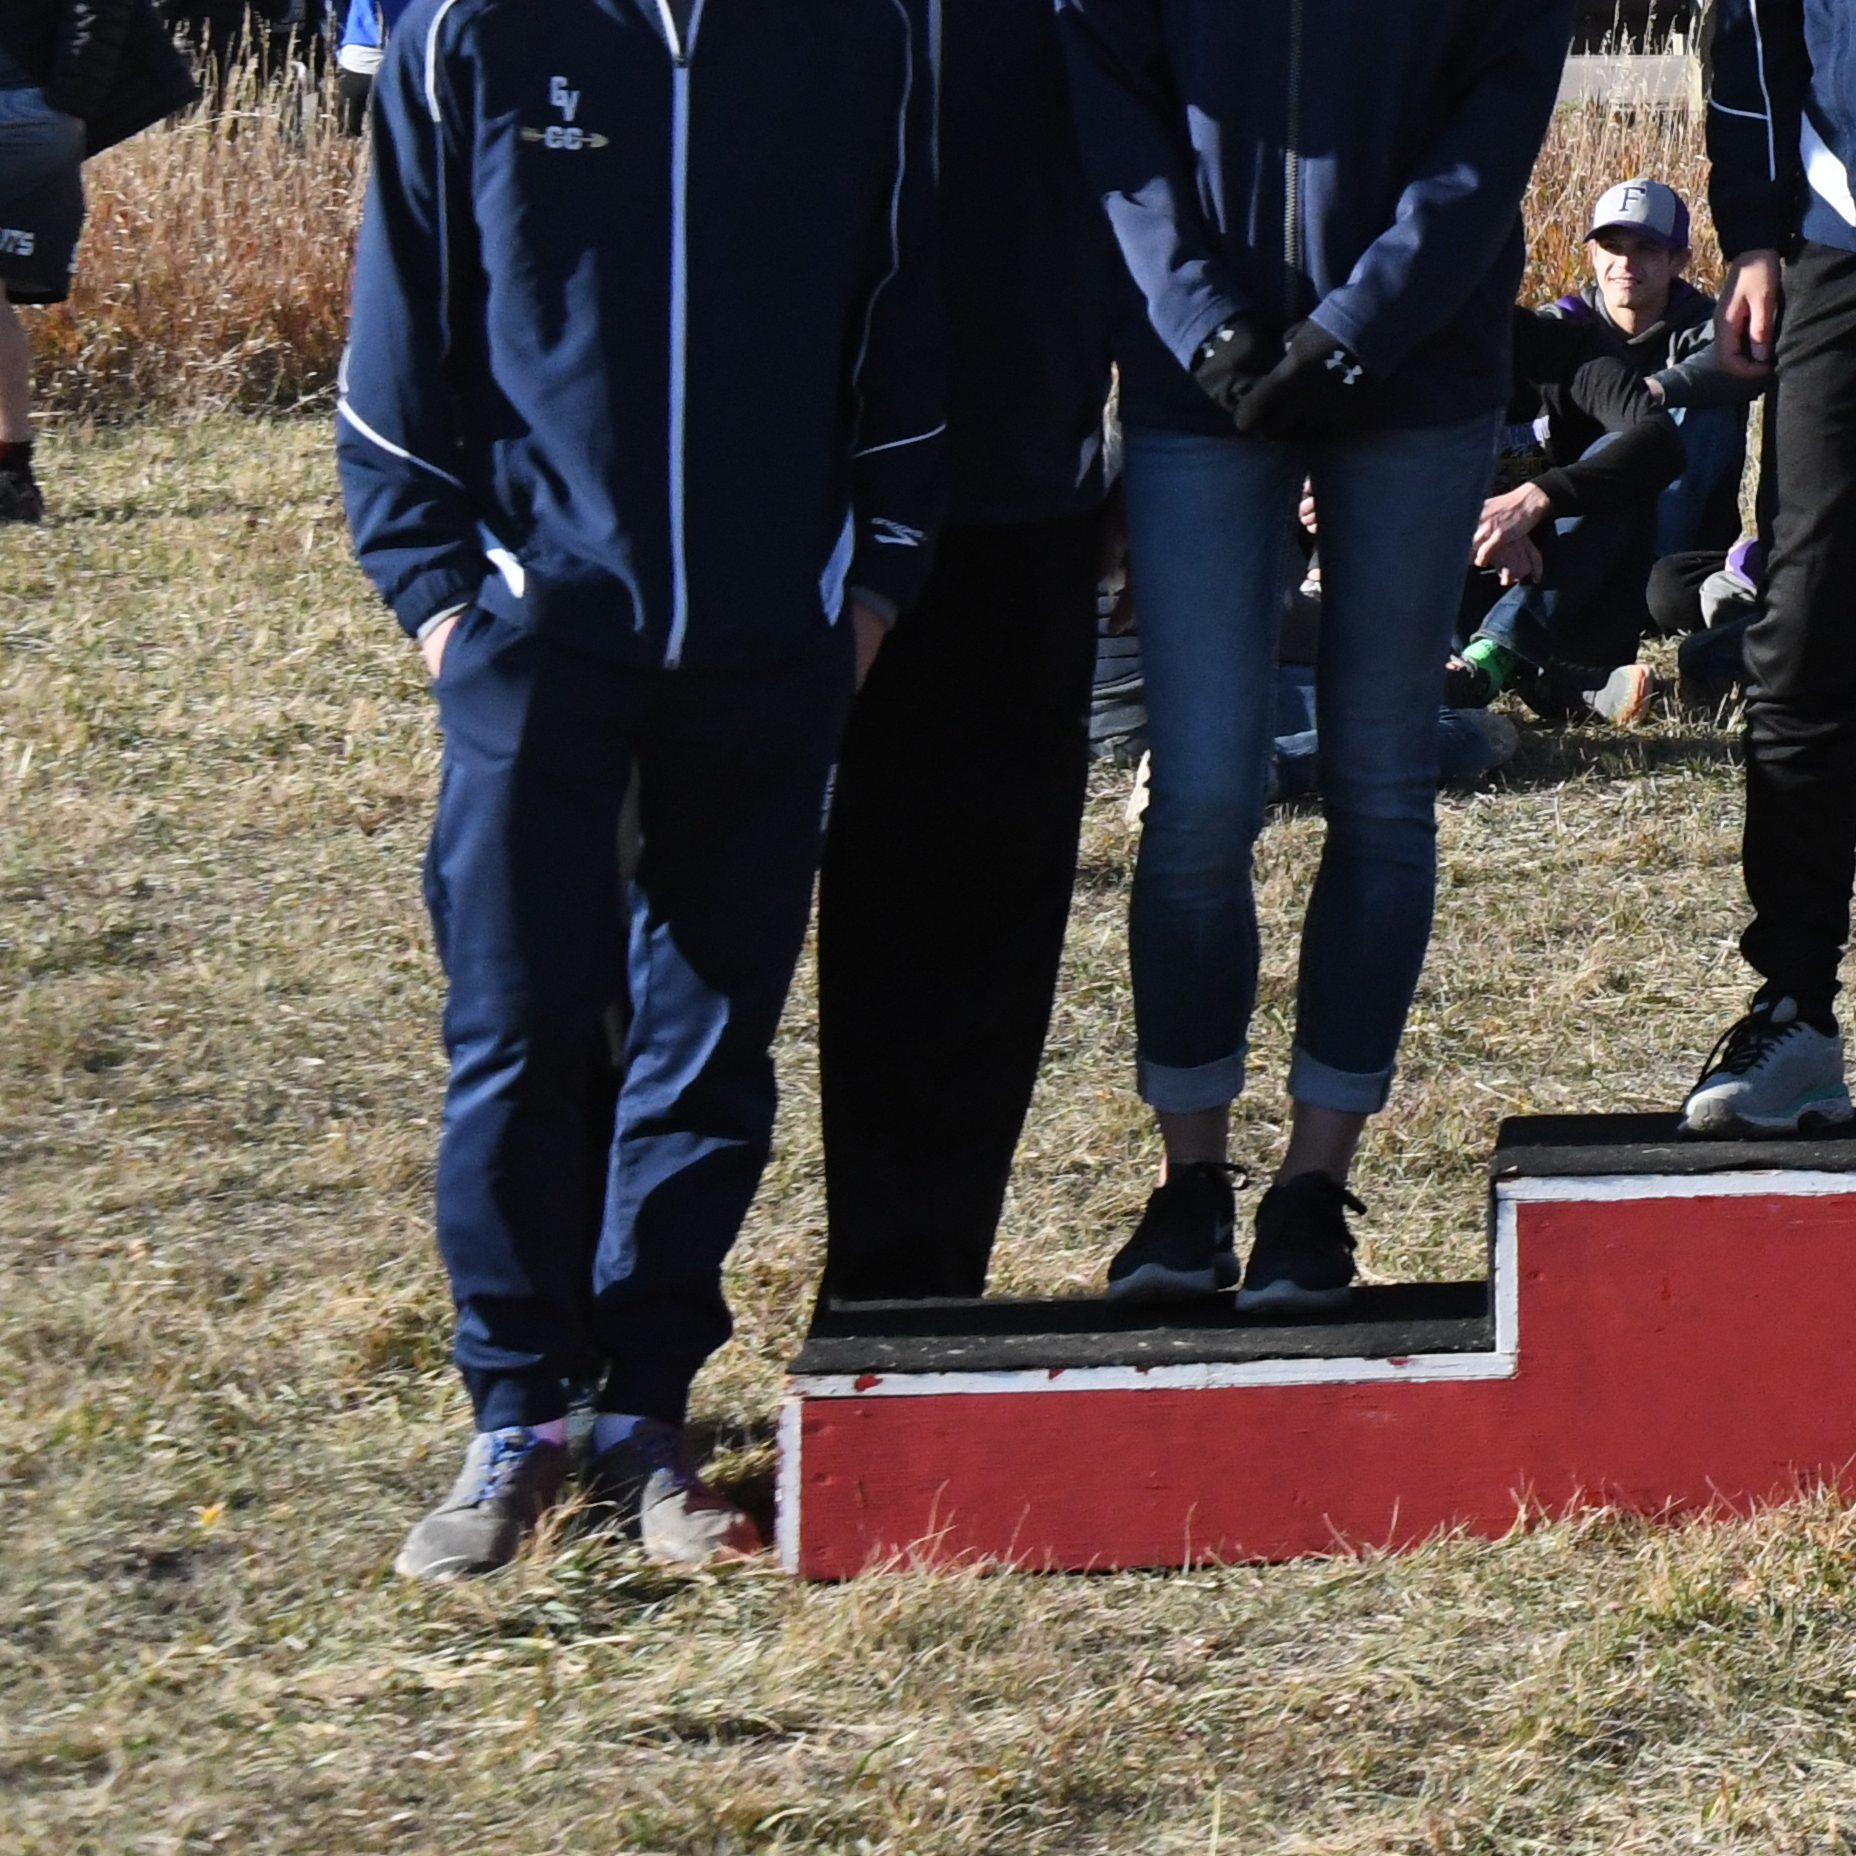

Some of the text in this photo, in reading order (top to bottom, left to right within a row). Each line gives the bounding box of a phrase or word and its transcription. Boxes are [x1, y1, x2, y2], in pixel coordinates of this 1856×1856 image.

[550, 76, 580, 121] GV
[545, 126, 583, 149] CC
[1618, 187, 1646, 212] F
